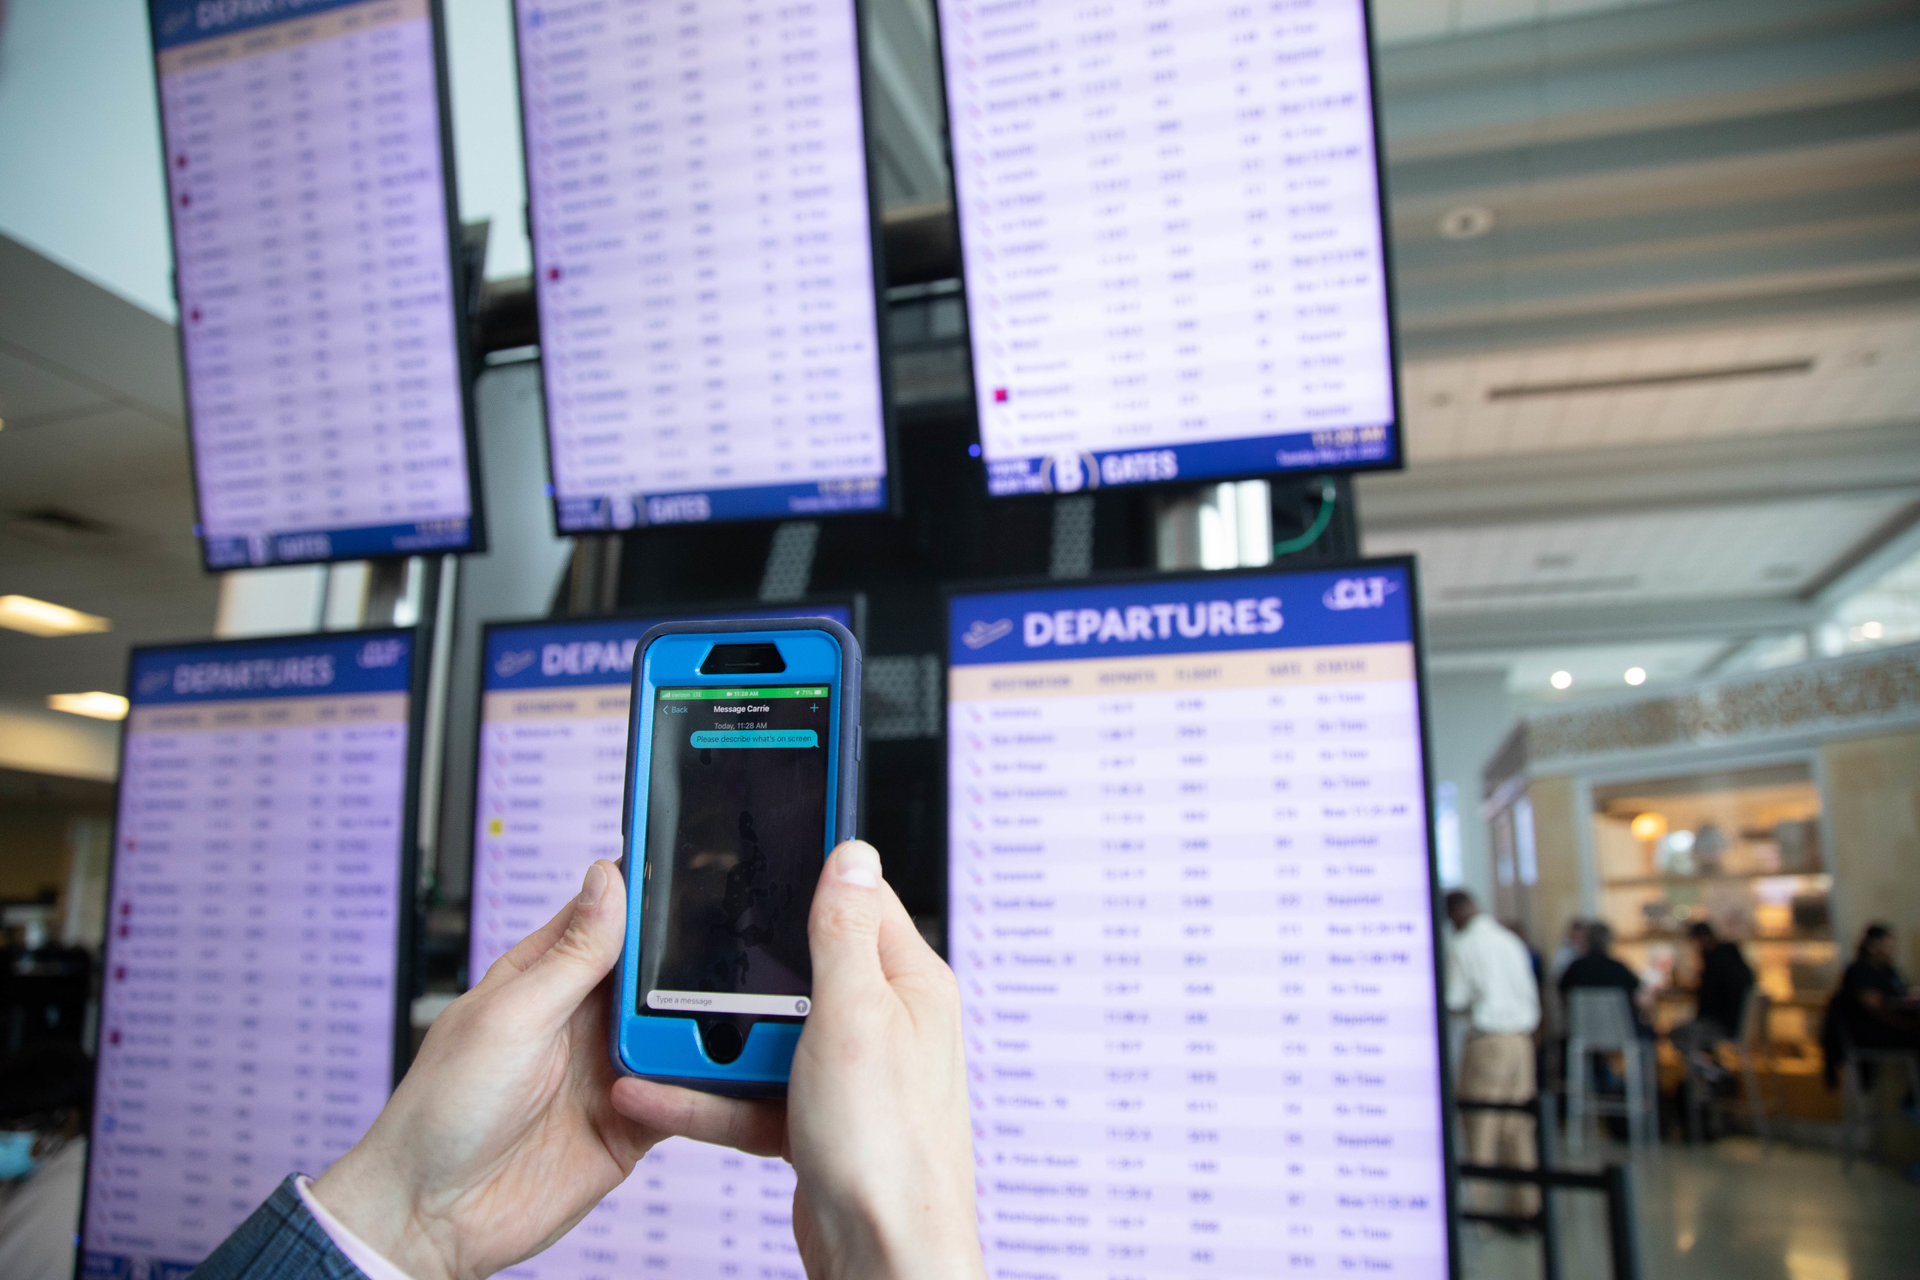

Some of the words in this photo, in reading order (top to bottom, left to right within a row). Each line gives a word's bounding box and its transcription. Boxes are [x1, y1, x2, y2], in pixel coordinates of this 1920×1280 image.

[1101, 451, 1178, 482] GATES
[1023, 597, 1284, 647] DEPARTURES
[173, 654, 335, 693] DEPARTURES
[671, 706, 688, 714] Back
[713, 705, 746, 714] Message
[747, 704, 770, 713] Carrie
[714, 722, 735, 730] Today,
[697, 735, 719, 743] Please
[721, 734, 750, 743] describe
[752, 734, 775, 743] what's
[788, 735, 811, 743] screen
[656, 996, 673, 1005] Type
[680, 997, 712, 1006] message
